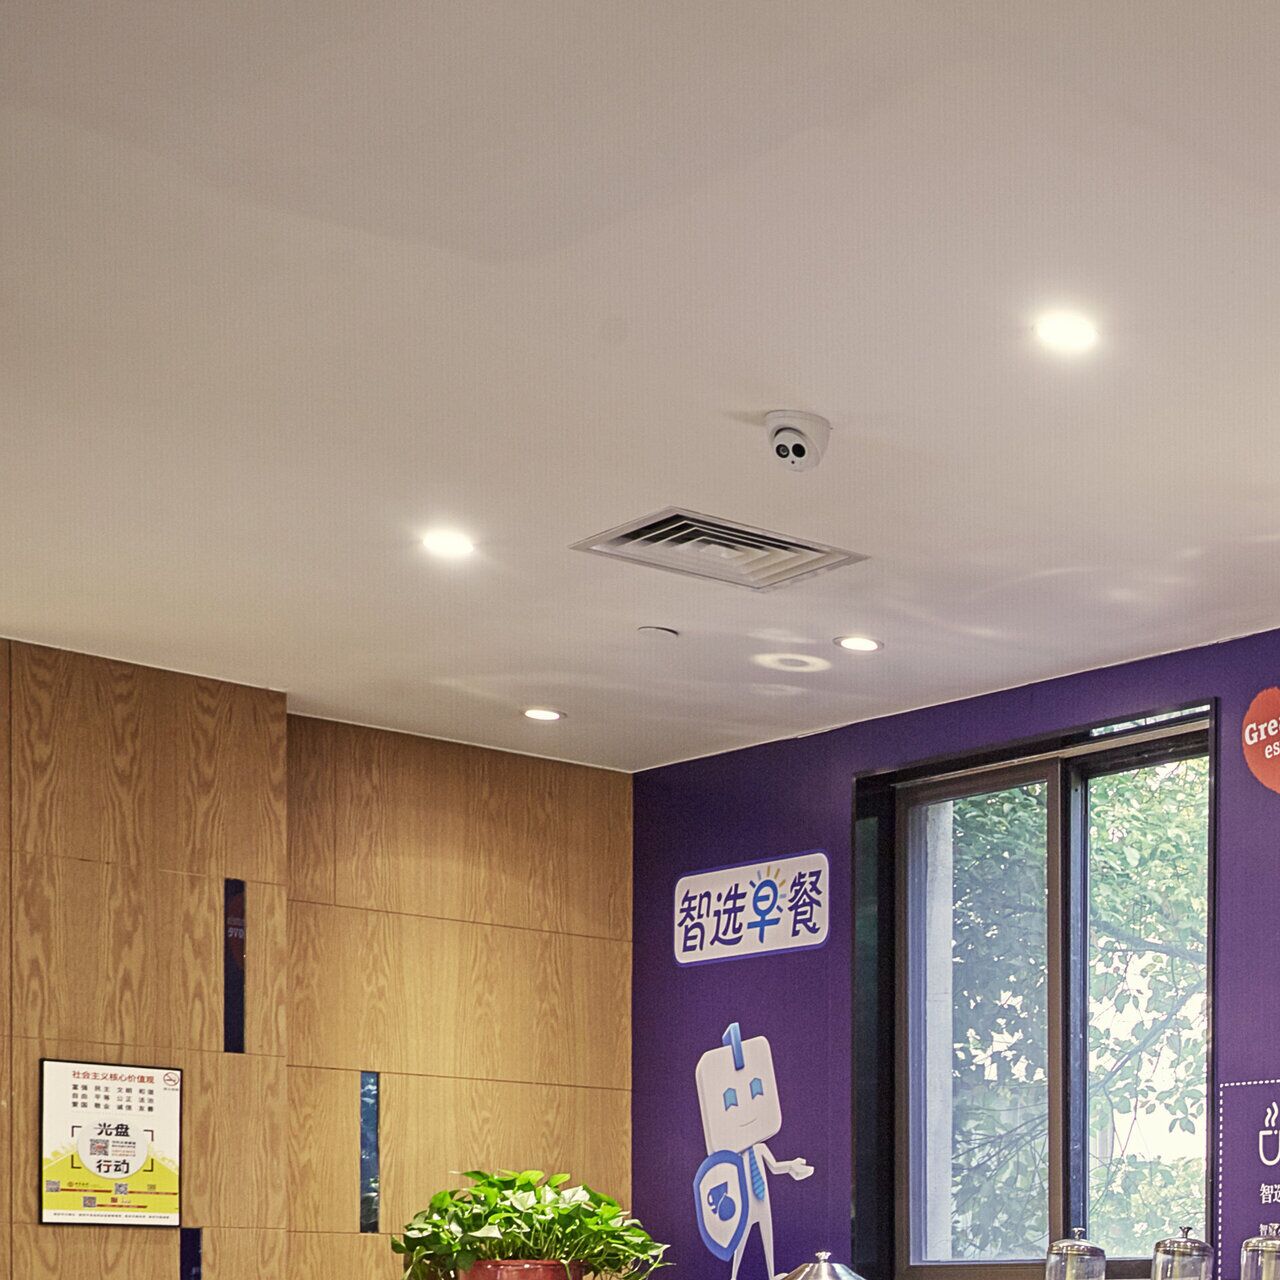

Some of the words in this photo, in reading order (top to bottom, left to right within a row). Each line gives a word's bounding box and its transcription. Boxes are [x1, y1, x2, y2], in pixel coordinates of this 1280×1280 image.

[677, 869, 823, 953] 智选早餐
[72, 1070, 155, 1084] 社会主义核心价值观
[97, 1122, 130, 1137] 光盘
[96, 1159, 130, 1174] 行动
